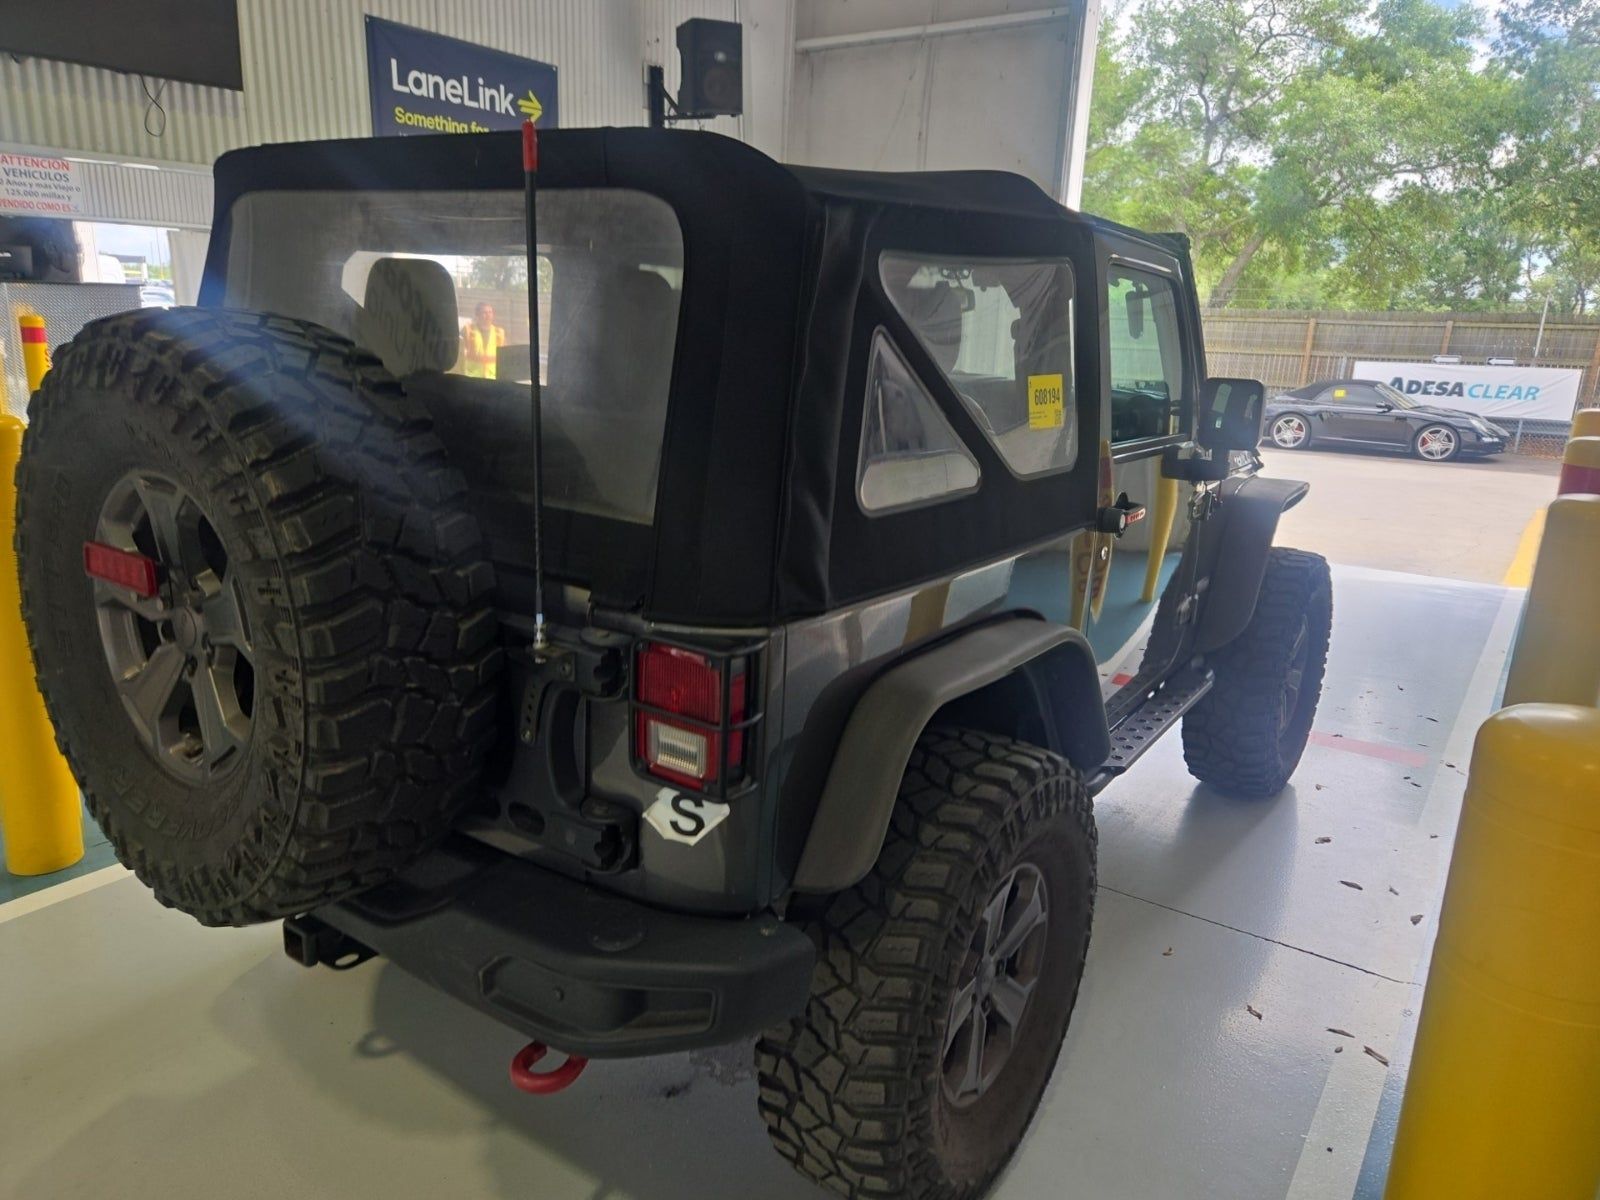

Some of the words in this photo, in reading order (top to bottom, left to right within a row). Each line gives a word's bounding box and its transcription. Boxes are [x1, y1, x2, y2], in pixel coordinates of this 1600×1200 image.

[390, 57, 516, 117] LaneLink
[394, 106, 469, 134] Something
[0, 154, 70, 171] ATTENCION
[2, 167, 70, 182] VEHICULOS
[1034, 387, 1060, 406] 608194
[1390, 377, 1464, 397] ADESA
[1468, 383, 1540, 400] CLEAR
[669, 795, 705, 837] S
